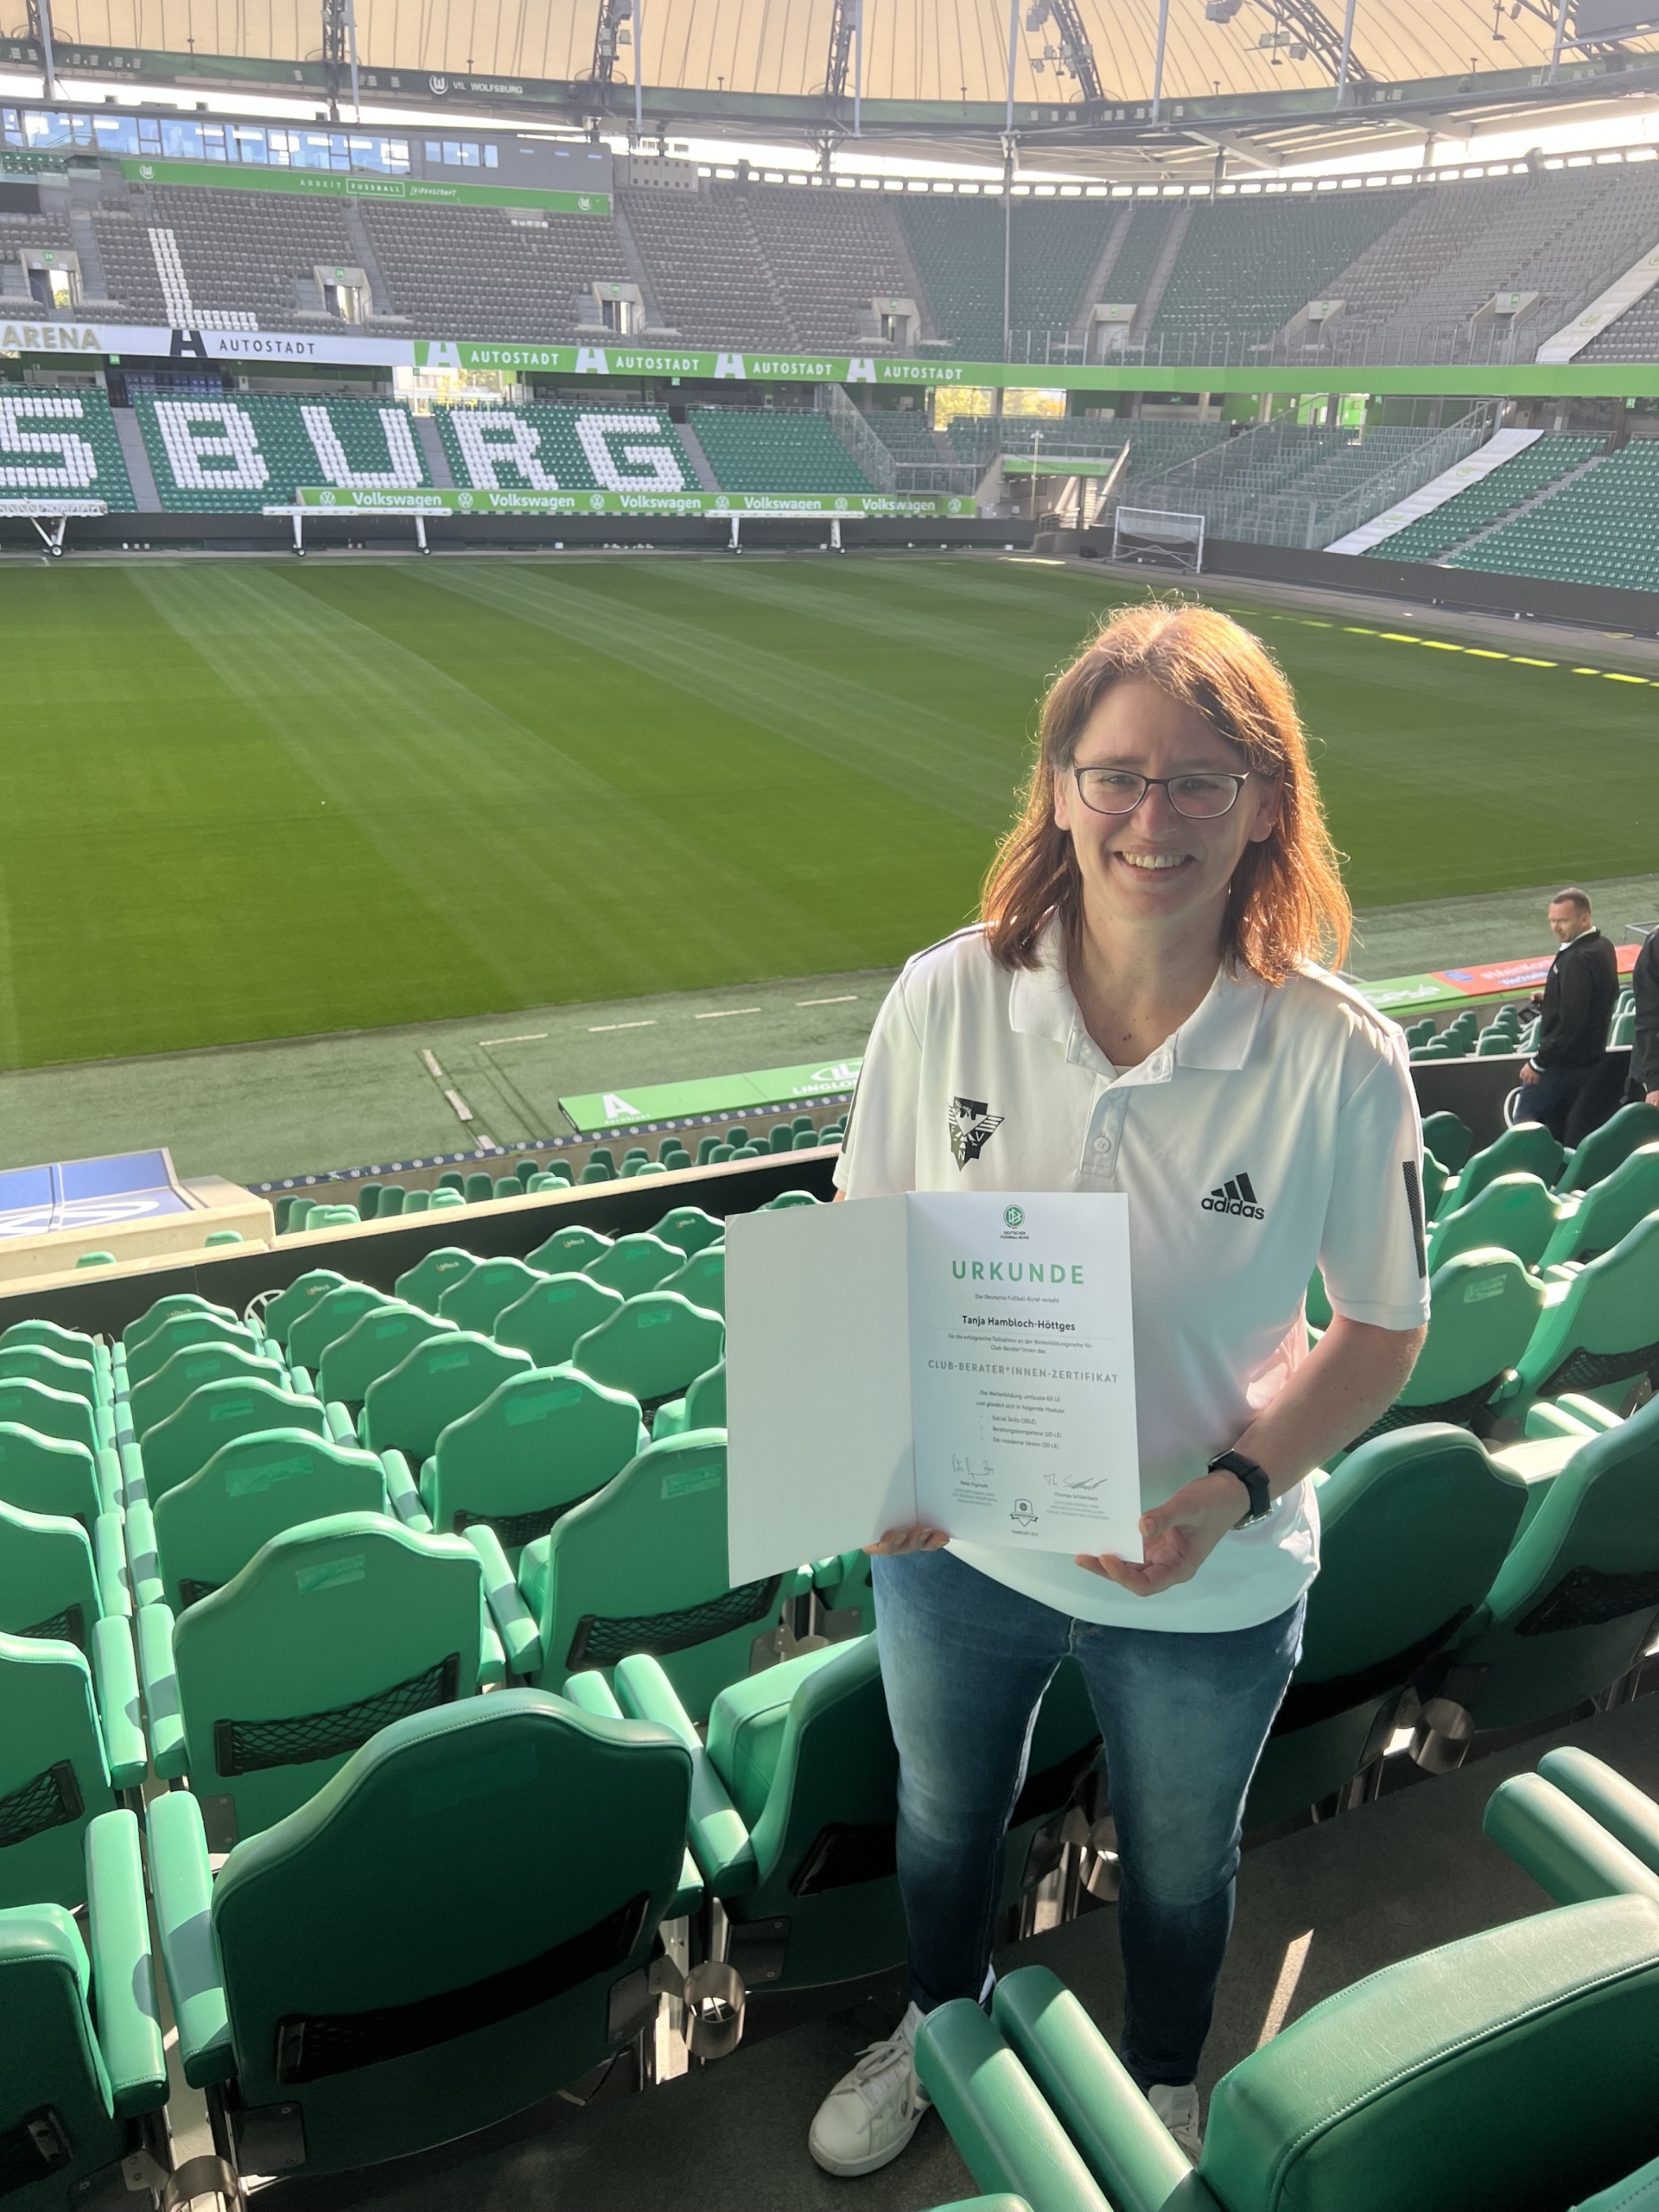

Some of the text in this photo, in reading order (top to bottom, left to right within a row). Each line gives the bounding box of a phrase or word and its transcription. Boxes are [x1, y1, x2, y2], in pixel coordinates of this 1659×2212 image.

[470, 82, 523, 94] WOLFSBURG
[300, 179, 342, 188] ARBEIT
[351, 183, 400, 193] FUSSBALL
[3, 325, 102, 350] ARENA
[219, 339, 315, 355] AUTOSTADT
[471, 349, 560, 365] AUTOSTADT
[615, 356, 700, 371] AUTOSTADT
[753, 361, 833, 376] AUTOSTADT
[883, 365, 963, 380] AUTOSTADT
[352, 492, 442, 509] Volkswagen
[489, 493, 575, 509] Volkswagen
[620, 494, 701, 511] Volkswagen
[743, 496, 822, 512] Volkswagen
[861, 499, 936, 512] Volkswagen
[1201, 1195, 1265, 1220] adidas
[952, 1260, 1084, 1285] URKUNDE
[962, 1315, 1076, 1332] Tanja Hambloch-Höttges
[1033, 1339, 1084, 1349] Weiterbildungsreihe
[988, 1390, 1023, 1400] Weiterbildung
